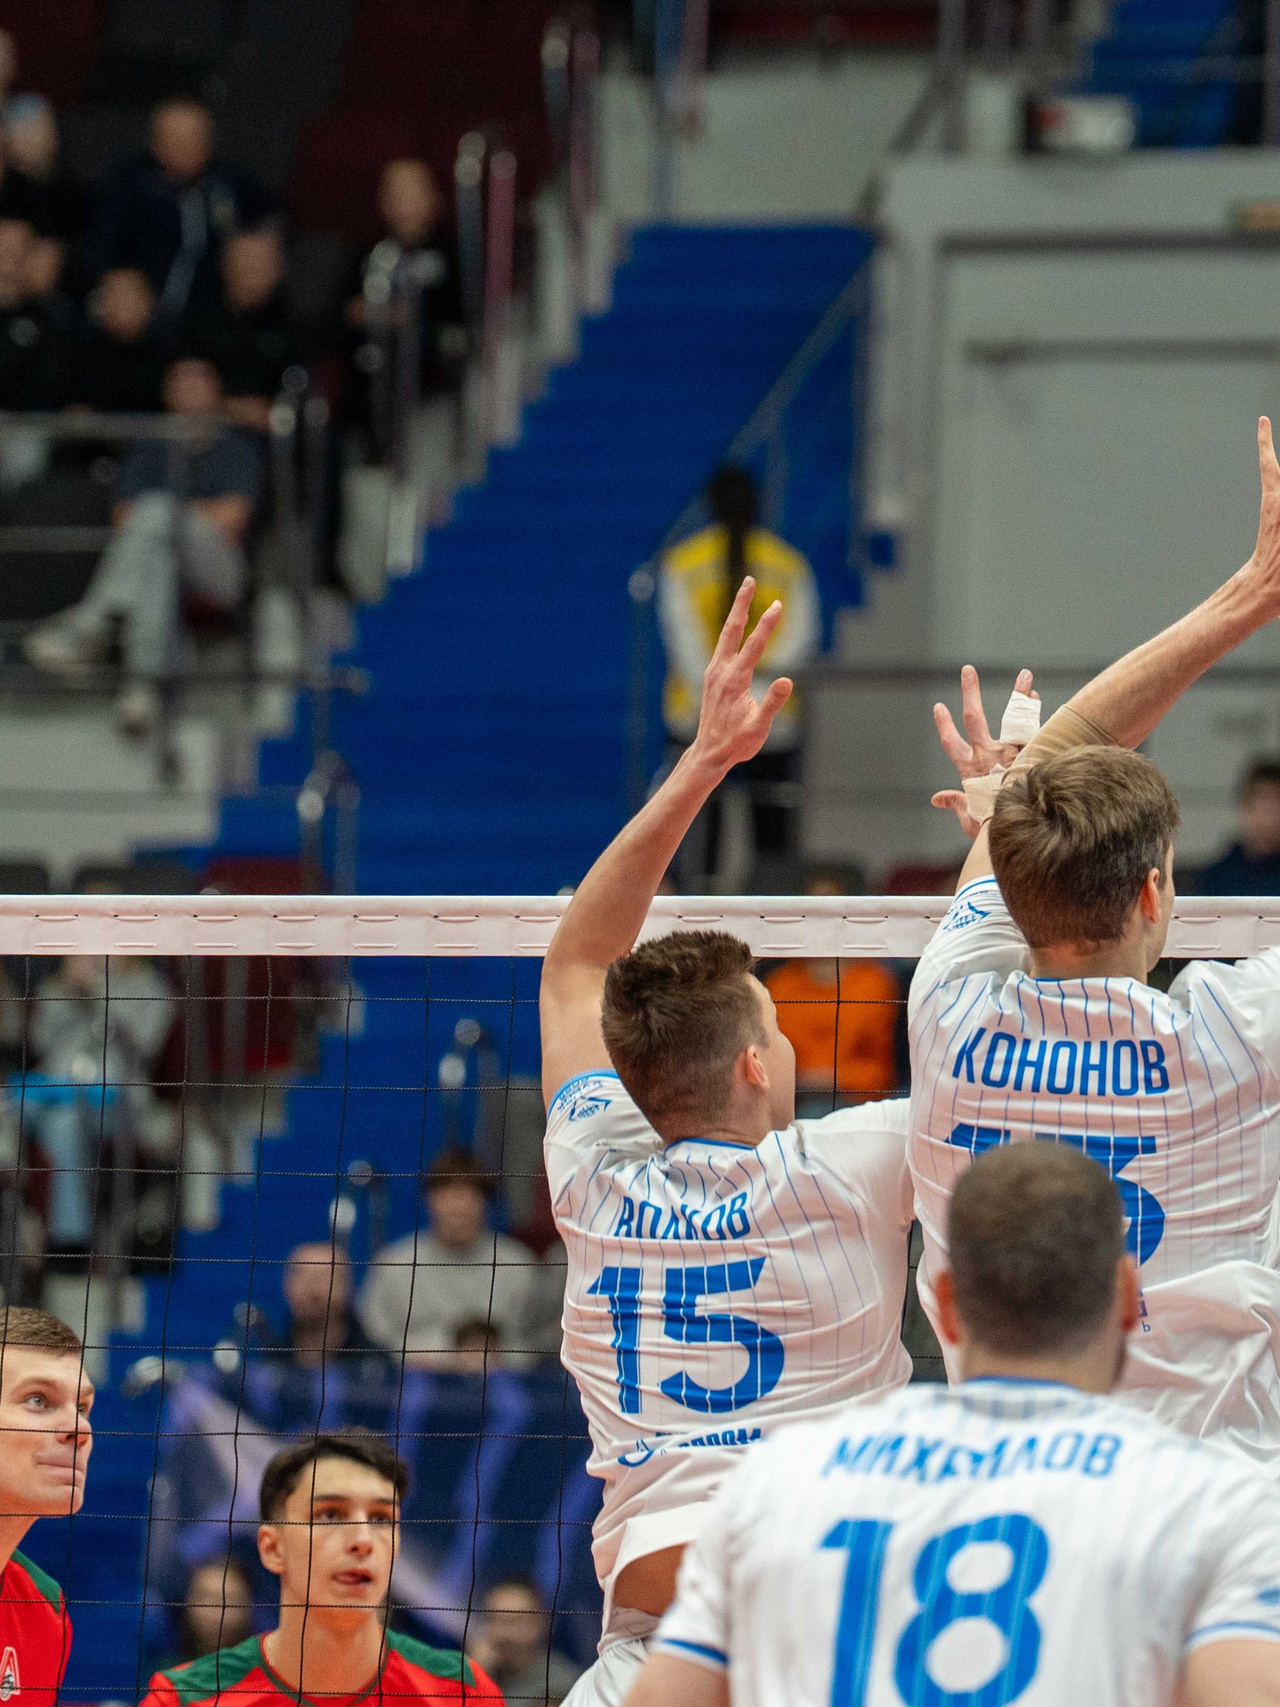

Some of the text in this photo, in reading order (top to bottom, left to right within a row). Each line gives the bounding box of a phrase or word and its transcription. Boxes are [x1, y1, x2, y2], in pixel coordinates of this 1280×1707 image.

[952, 1027, 1170, 1096] КОНОНОВ
[586, 1256, 785, 1415] 15
[817, 1515, 1050, 1707] 18
